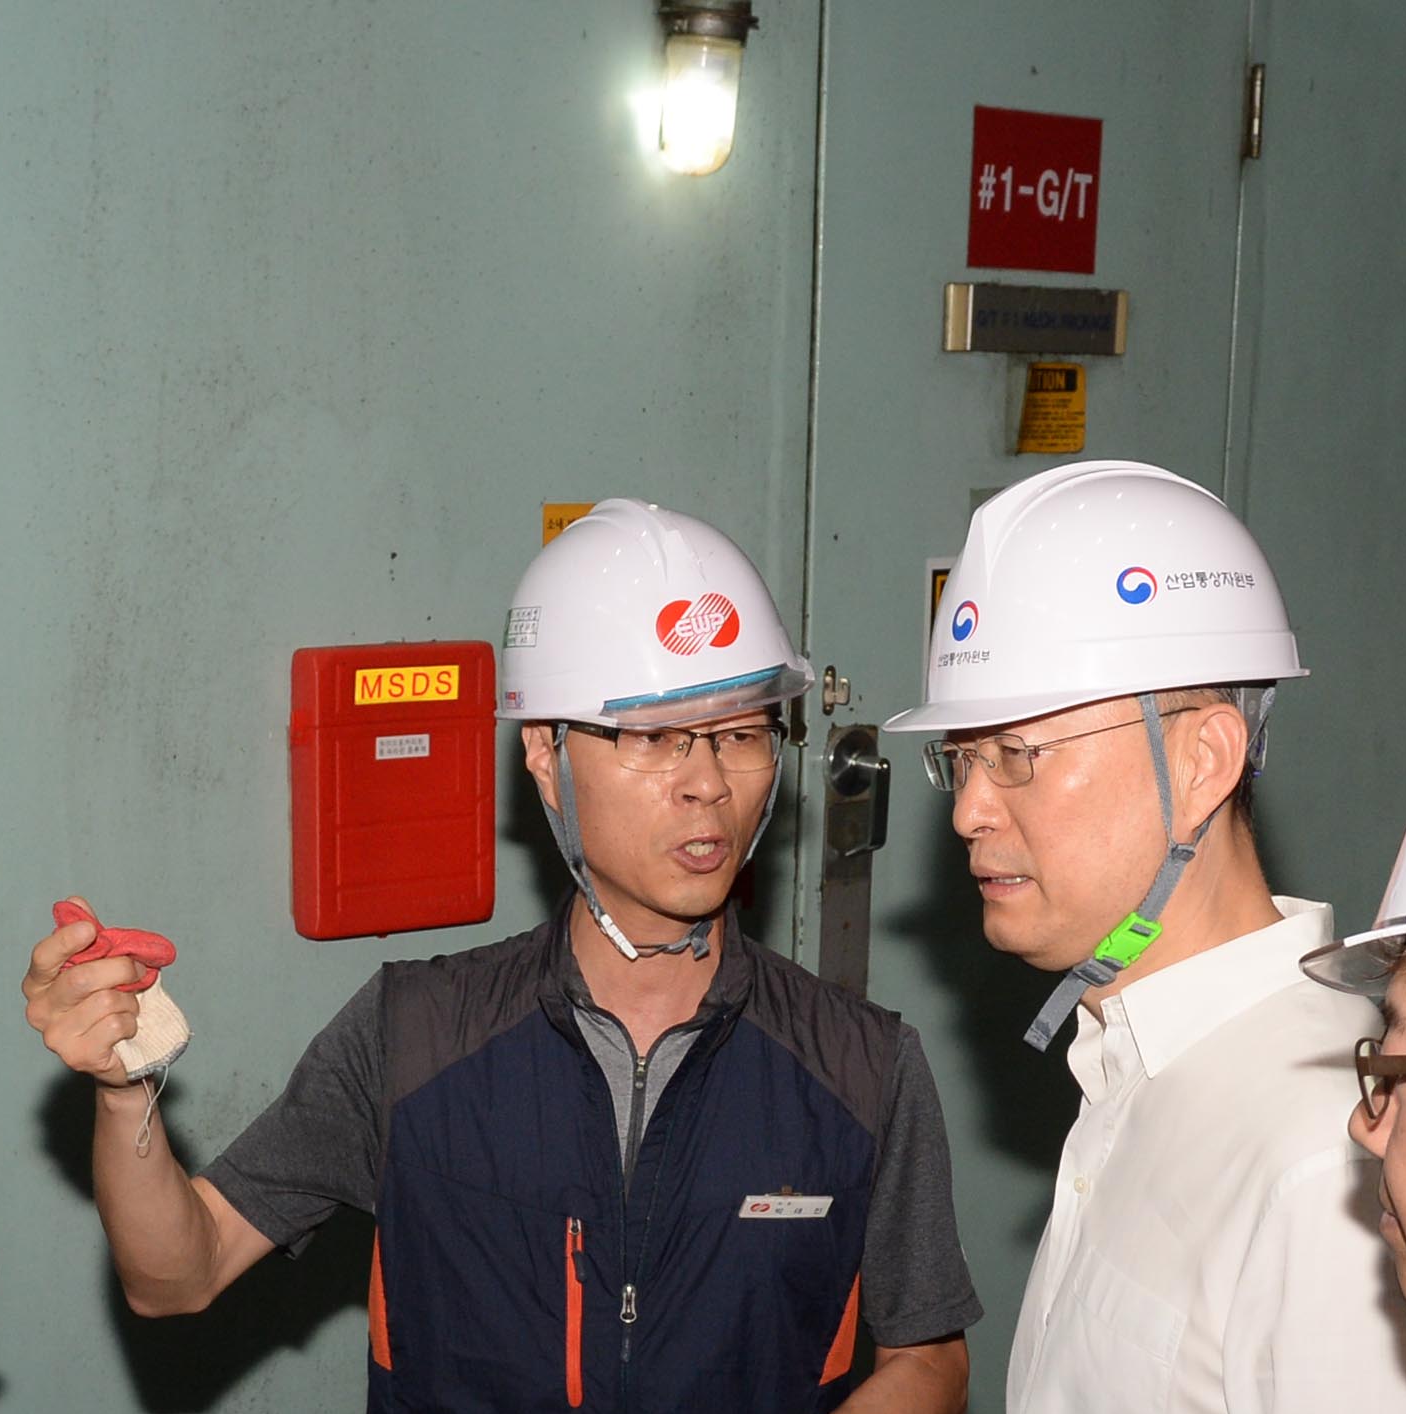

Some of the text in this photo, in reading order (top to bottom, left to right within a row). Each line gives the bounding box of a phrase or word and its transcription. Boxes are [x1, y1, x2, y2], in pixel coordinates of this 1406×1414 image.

[978, 163, 1094, 222] #1-G/T
[1164, 569, 1257, 592] 산업통상자원부
[674, 612, 726, 639] EWP
[360, 670, 453, 700] MSDS
